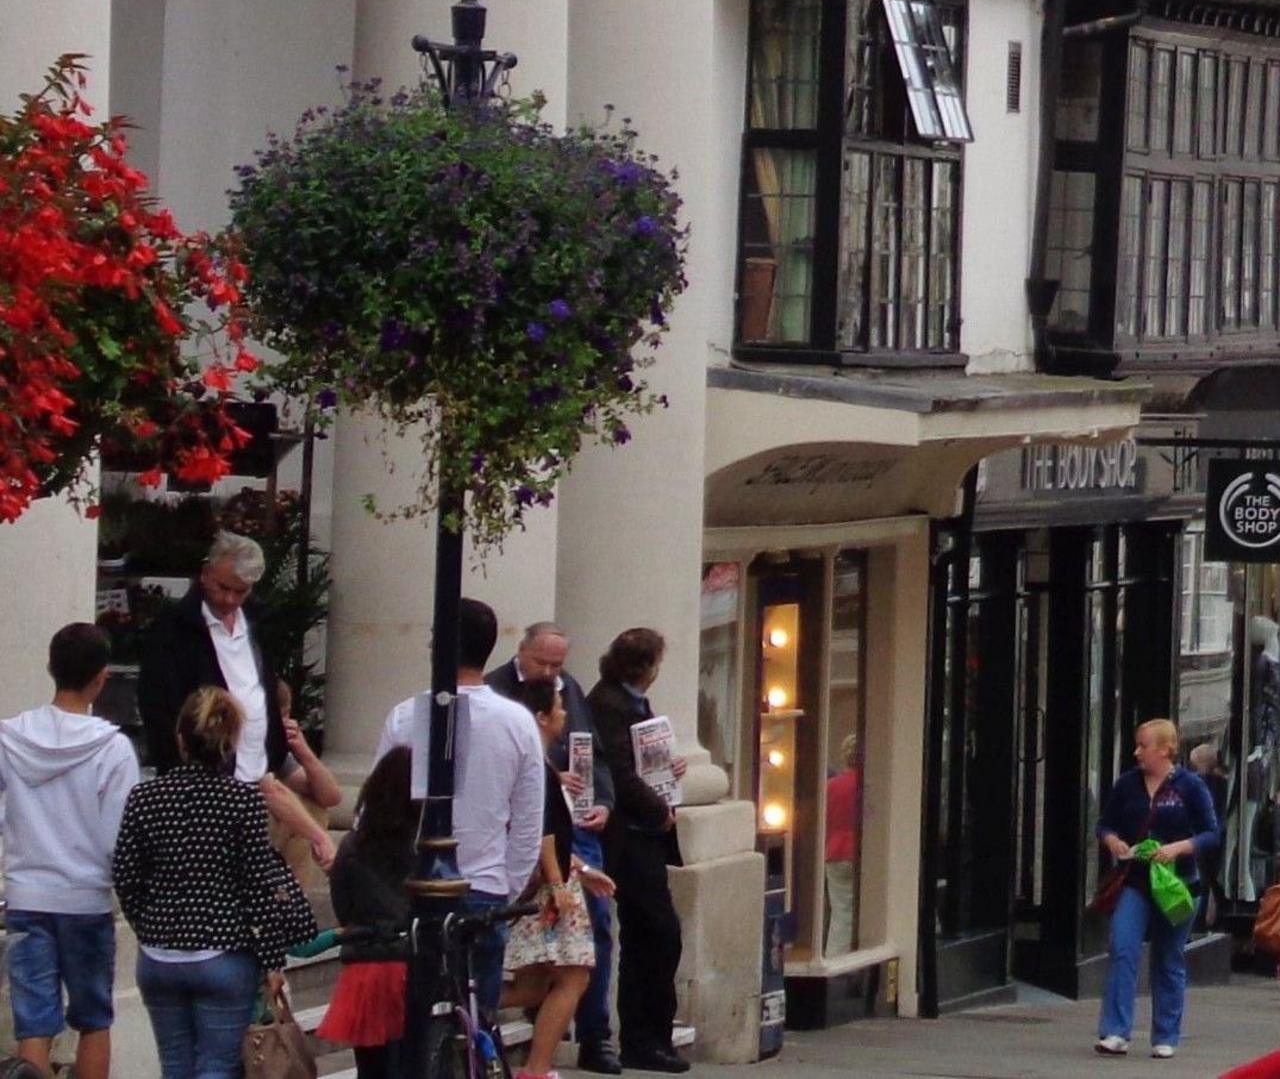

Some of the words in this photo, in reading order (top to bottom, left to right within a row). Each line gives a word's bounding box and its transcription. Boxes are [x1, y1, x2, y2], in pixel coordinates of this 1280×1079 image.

[1057, 444, 1098, 489] BODY
[1099, 439, 1137, 488] SHOP
[1244, 495, 1271, 508] THE
[1234, 507, 1280, 520] BODY
[1236, 520, 1278, 534] SHOP
